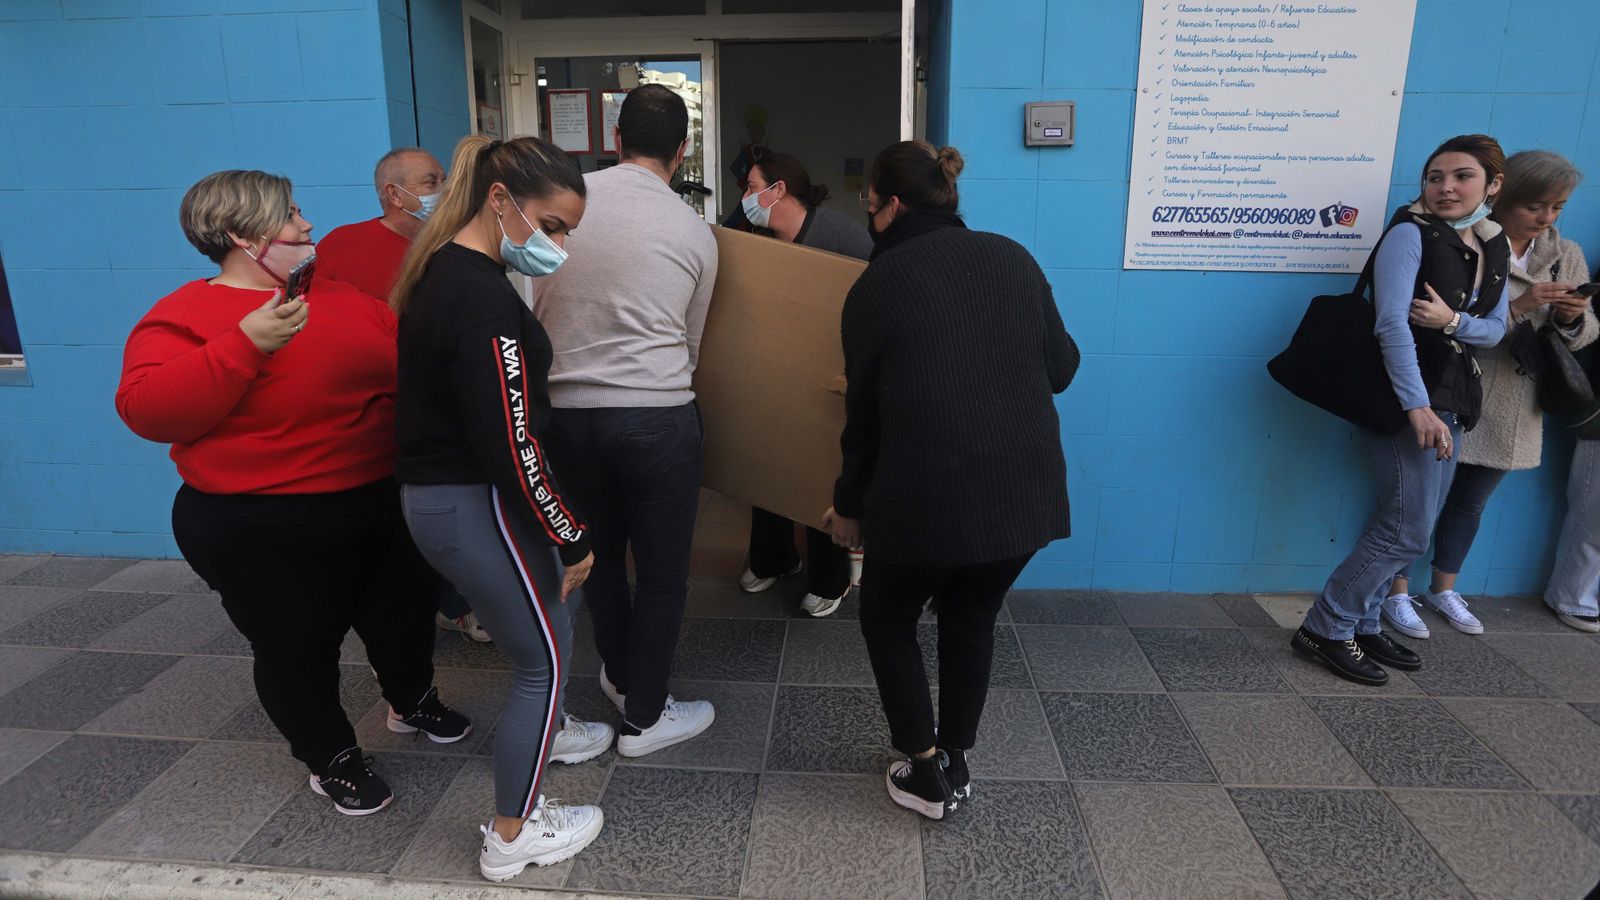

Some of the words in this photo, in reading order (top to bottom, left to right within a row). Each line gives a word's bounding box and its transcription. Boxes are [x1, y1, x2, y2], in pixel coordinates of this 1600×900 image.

[1178, 4, 1202, 13] Clases
[1204, 4, 1214, 13] de
[1216, 6, 1240, 16] apoyo
[1242, 4, 1270, 13] escolar
[1280, 4, 1316, 16] Refuerzo
[1318, 5, 1357, 14] Educativo
[1176, 19, 1212, 28] Atención
[1214, 19, 1257, 31] Temprana
[1277, 19, 1300, 29] años)
[1175, 34, 1225, 46] Modificación
[1226, 34, 1236, 43] de
[1238, 35, 1274, 43] conducta
[1174, 49, 1209, 58] Atención
[1211, 49, 1253, 61] Psicológica
[1320, 53, 1326, 62] y
[1328, 50, 1357, 59] adultos
[1172, 64, 1216, 73] Valoración
[1217, 67, 1224, 75] y
[1225, 65, 1260, 73] atención
[1262, 65, 1327, 76] Neuropsicológica
[1171, 79, 1219, 88] Orientación
[1220, 79, 1255, 88] Familiar
[1170, 93, 1209, 104] Logopedia
[1169, 107, 1200, 119] Terapia
[1255, 109, 1300, 120] Integración
[1302, 109, 1340, 118] Sensorial
[1168, 122, 1207, 131] Educación
[1209, 126, 1214, 134] y
[1216, 122, 1246, 132] Gestión
[1248, 123, 1289, 132] Emocional
[1166, 136, 1189, 145] BRMT
[1165, 151, 1191, 159] Cursos
[1193, 154, 1199, 162] y
[1201, 152, 1232, 160] Talleres
[1233, 152, 1286, 163] ocupacionales
[1288, 155, 1307, 164] para
[1309, 155, 1344, 164] personas
[1345, 153, 1375, 162] adultas
[1180, 163, 1222, 172] diversidad
[1223, 164, 1261, 174] funcional
[1164, 176, 1191, 184] Talleres
[1192, 177, 1234, 185] innovadores
[1242, 177, 1277, 185] divertidos
[1162, 189, 1188, 198] Cursos
[1197, 189, 1239, 198] Formación
[1240, 192, 1288, 201] permanente
[1152, 206, 1316, 225] 627765565/956096089
[499, 335, 521, 380] WAY
[509, 388, 528, 442] ONLY
[520, 445, 540, 488] THE
[535, 486, 552, 504] IS
[543, 501, 582, 542] TRUTH
